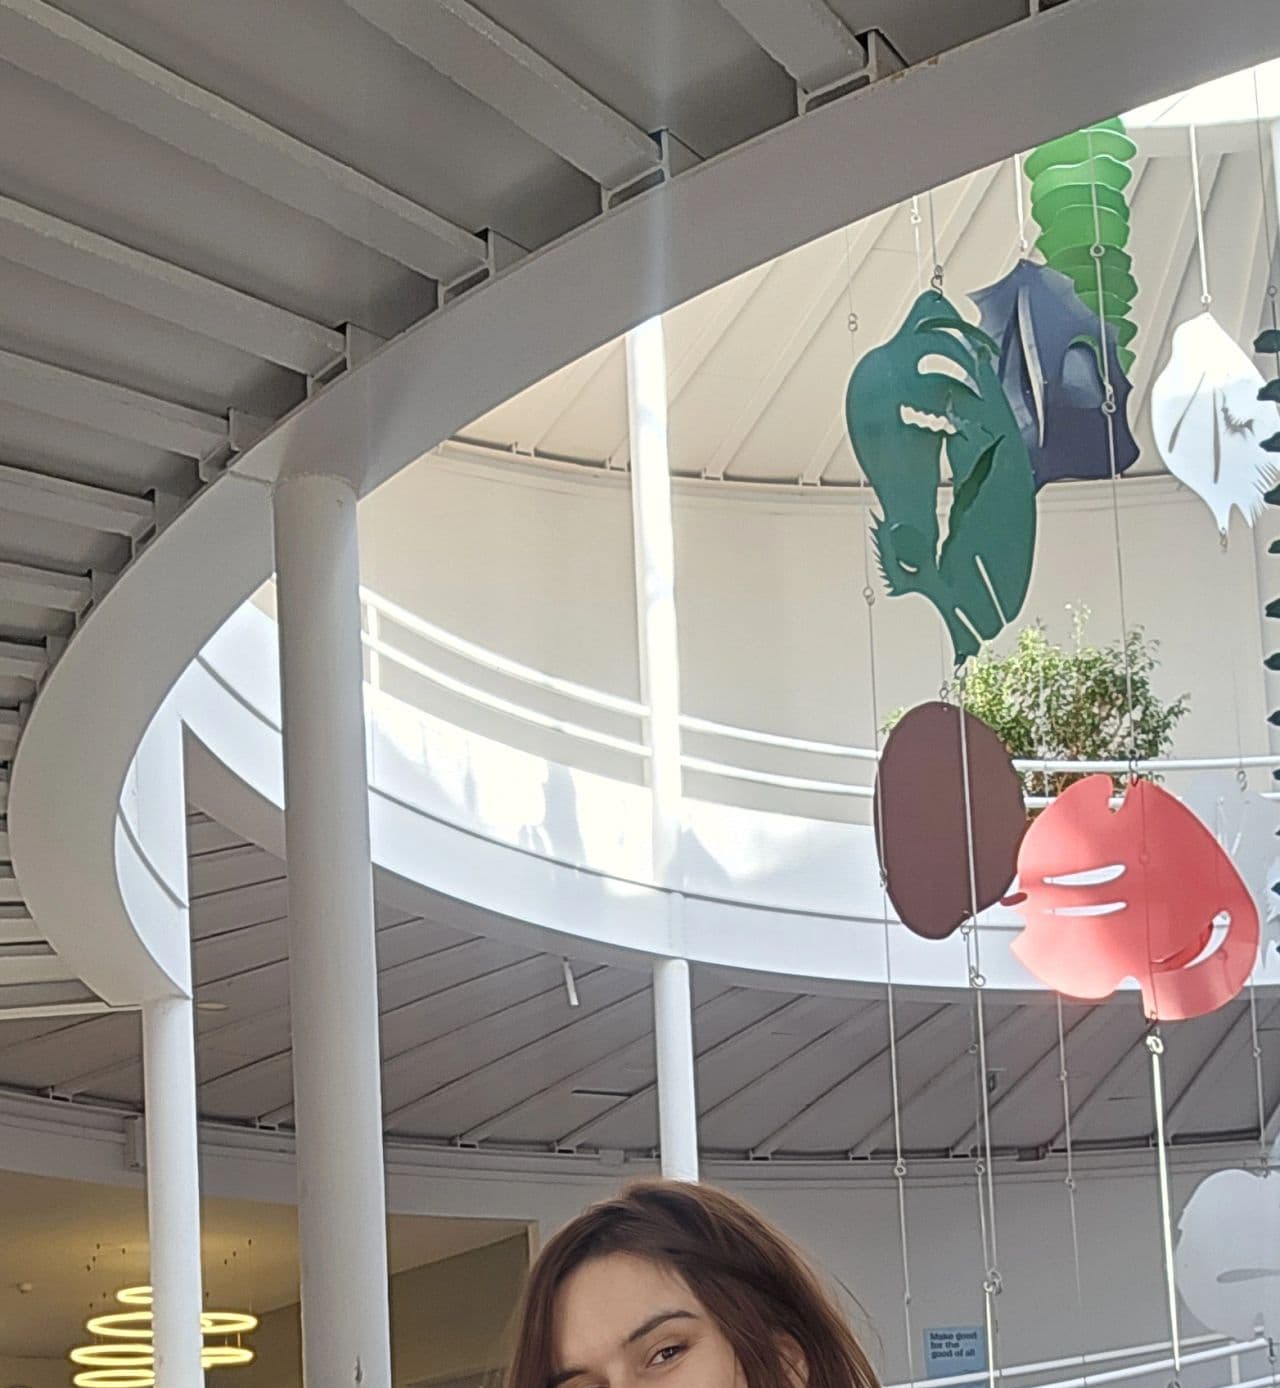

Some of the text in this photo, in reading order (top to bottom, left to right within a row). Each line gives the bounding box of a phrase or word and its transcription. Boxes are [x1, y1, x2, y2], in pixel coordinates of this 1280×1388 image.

[930, 1332, 976, 1341] Make good
[930, 1341, 943, 1349] for
[931, 1348, 976, 1359] good of all
